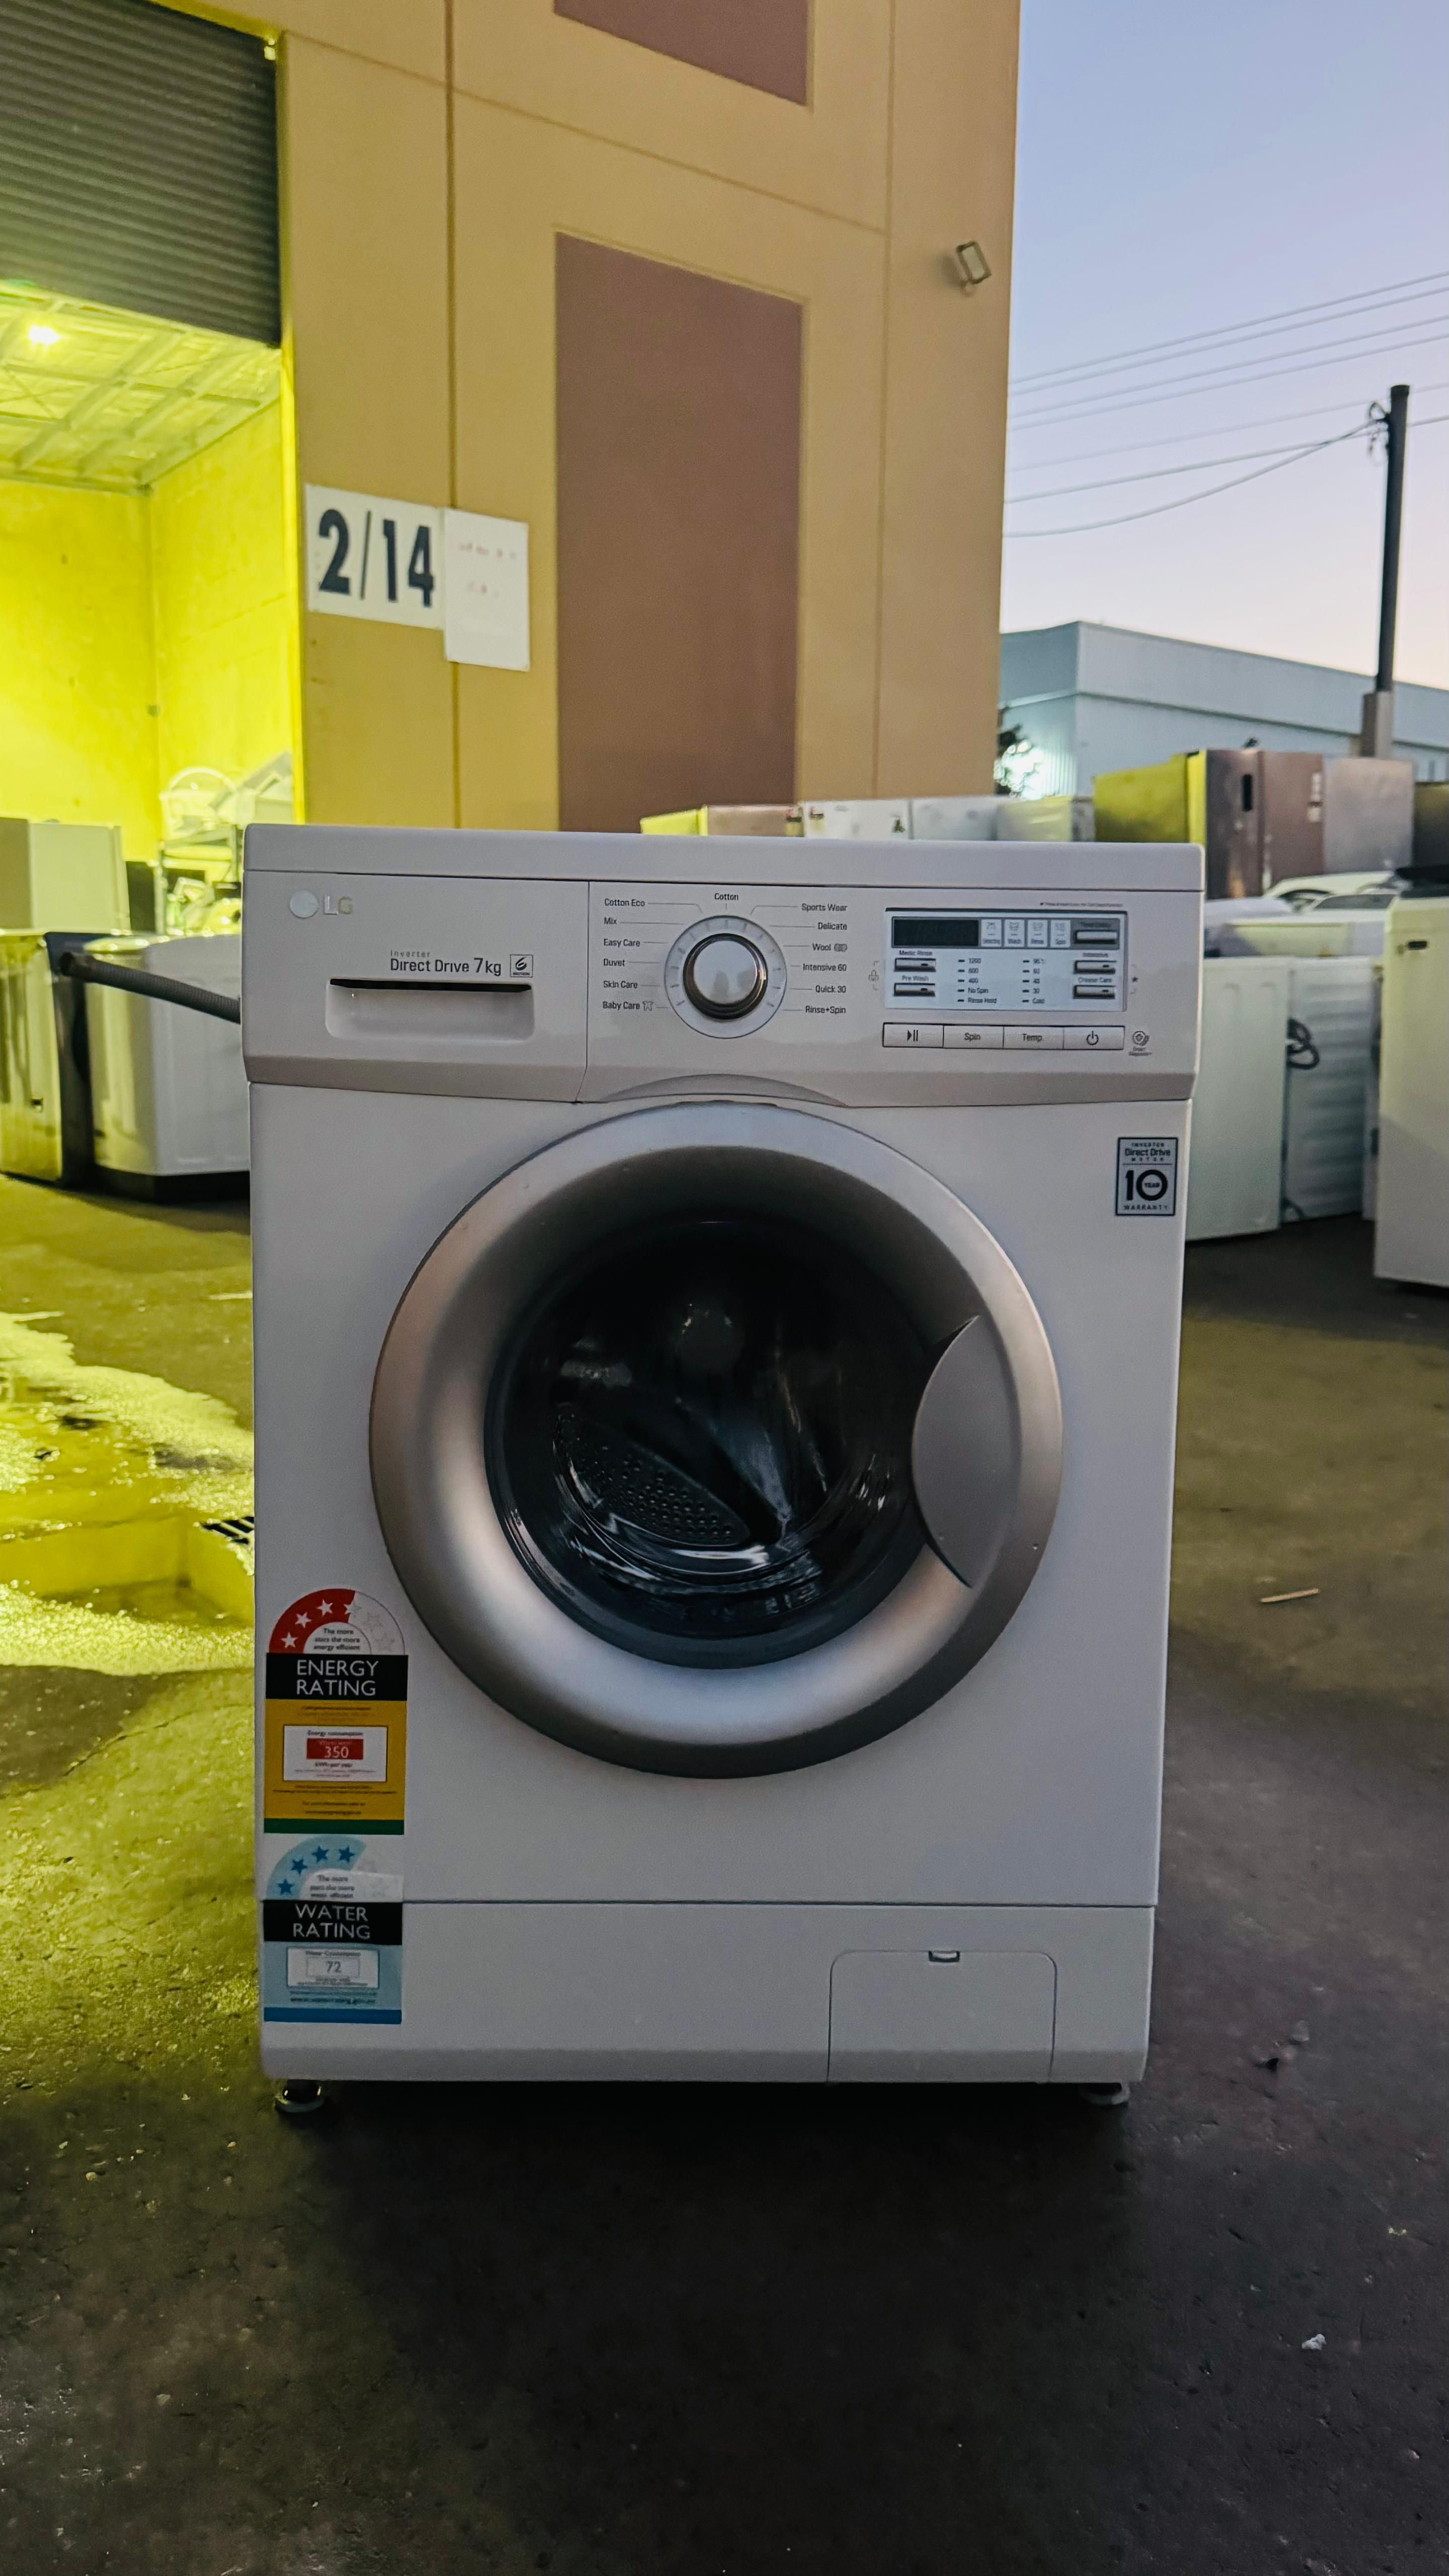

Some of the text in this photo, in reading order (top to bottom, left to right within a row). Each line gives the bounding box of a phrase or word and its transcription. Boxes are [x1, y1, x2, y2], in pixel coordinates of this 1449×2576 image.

[318, 509, 434, 608] 2/14
[714, 893, 739, 901] Cotton
[324, 895, 353, 915] LG
[604, 898, 645, 907] Cotton Eco
[801, 903, 848, 912] Sports Wear
[818, 922, 847, 930] Delicate
[604, 938, 640, 948] Easy Care
[813, 943, 831, 951] Wool
[390, 949, 431, 957] Inverter
[390, 958, 431, 972] Direct
[435, 959, 469, 973] Drive
[604, 958, 625, 966] Duvet
[803, 963, 836, 971] Intensive
[603, 980, 637, 989] Skin Care
[816, 985, 836, 993] Quick
[603, 1001, 640, 1010] Baby Care
[806, 1005, 846, 1015] Rinse+Spin
[964, 1032, 981, 1041] Spin
[1023, 1033, 1043, 1042] Temp
[1125, 1148, 1171, 1156] Direct Drive
[1125, 1169, 1168, 1201] 10
[297, 1659, 379, 1677] ENERGY
[296, 1679, 376, 1696] RATING
[324, 1746, 349, 1758] 350
[294, 1904, 368, 1921] WATER
[293, 1922, 370, 1939] RATING
[327, 1961, 342, 1973] 72
